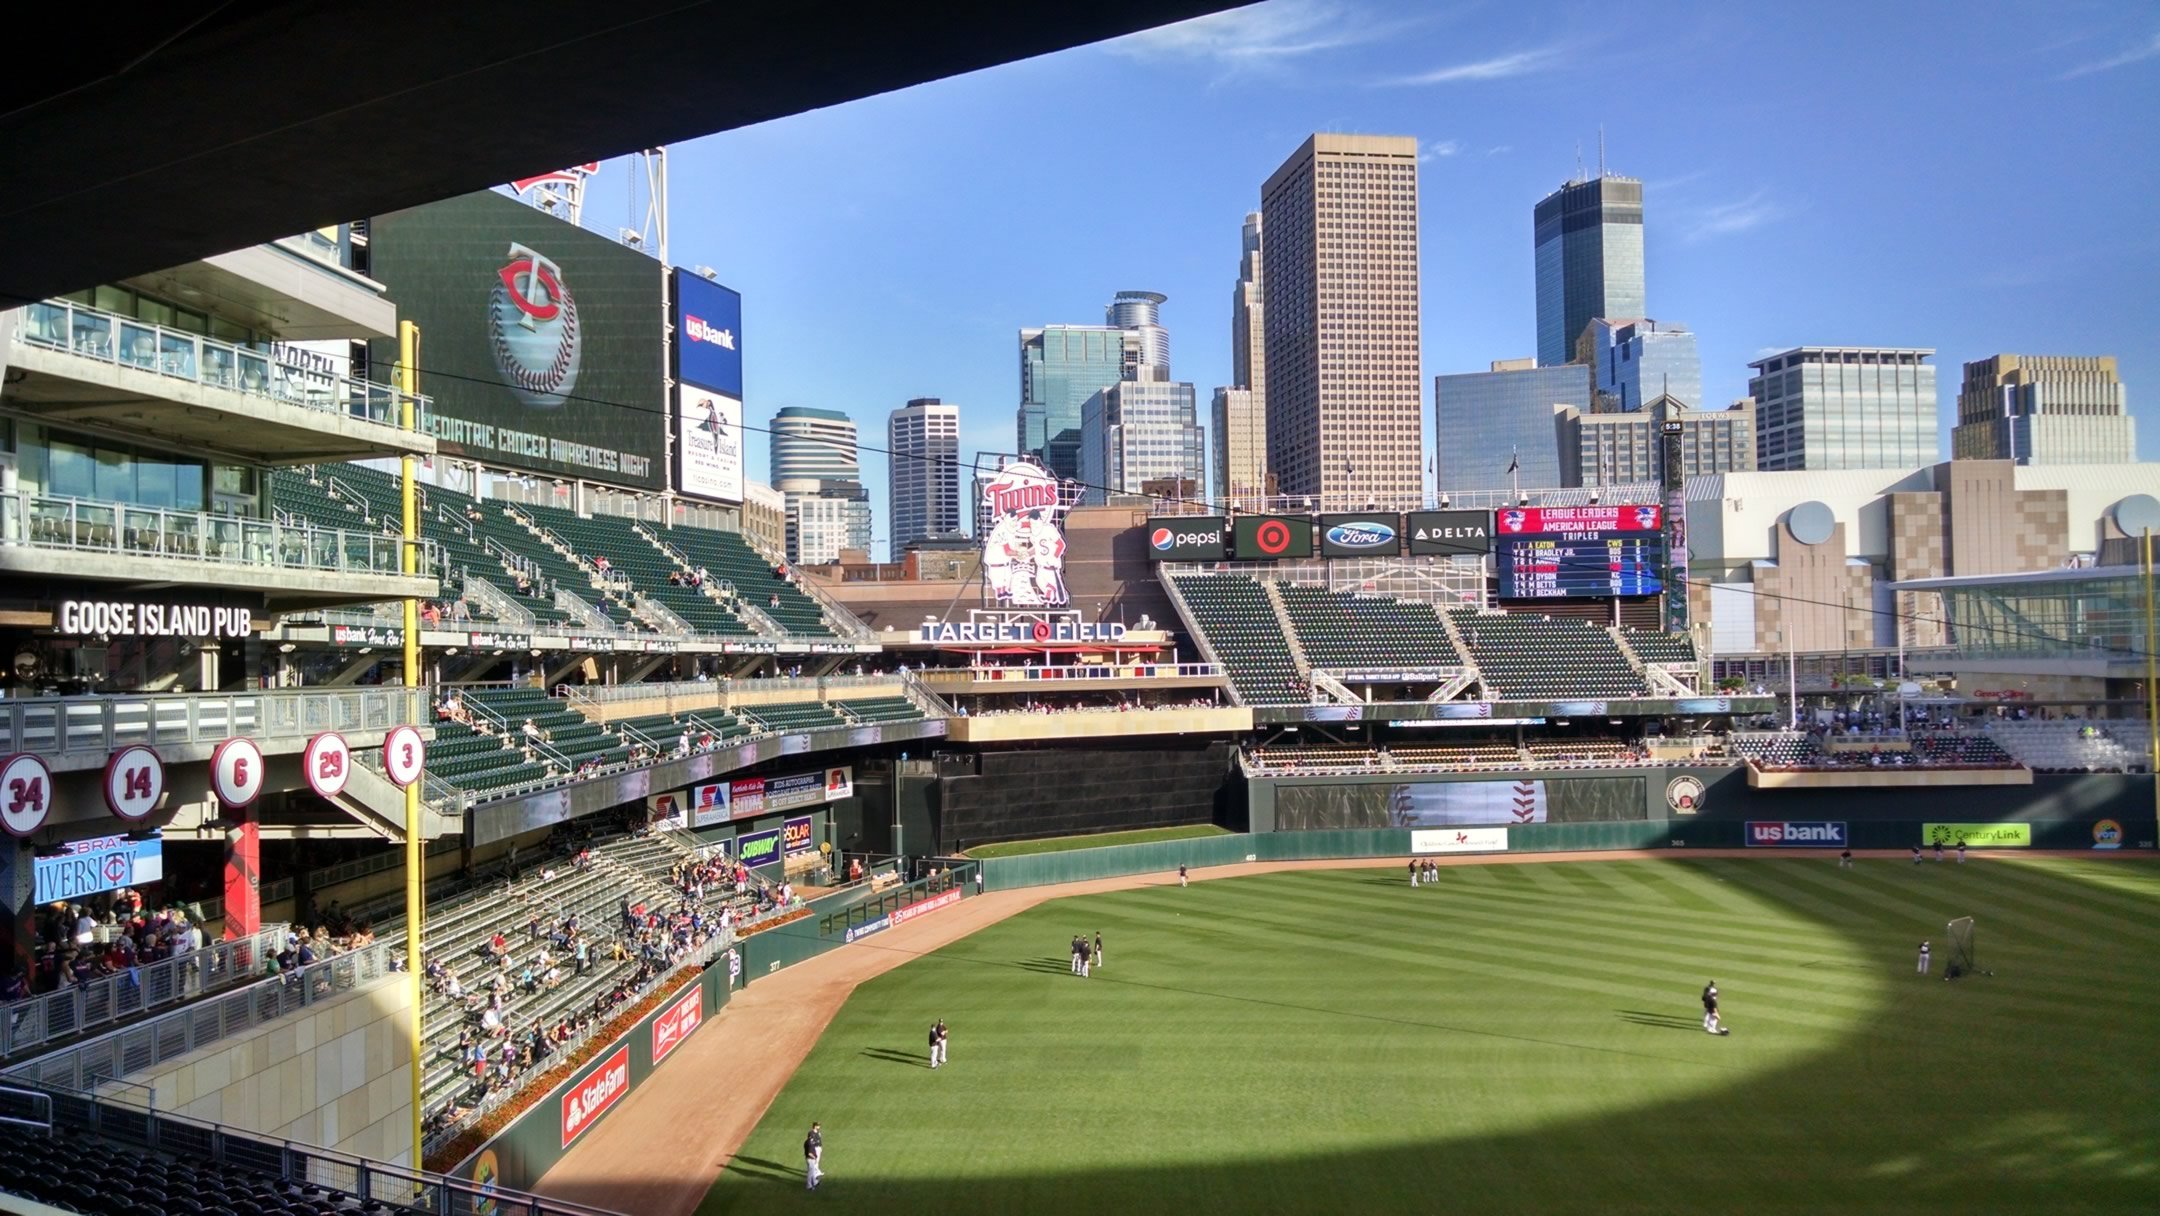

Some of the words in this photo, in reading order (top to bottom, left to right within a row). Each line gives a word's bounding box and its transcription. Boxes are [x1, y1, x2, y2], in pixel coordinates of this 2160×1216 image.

[424, 414, 494, 449] PEDIATRIC
[498, 428, 547, 459] CANCER
[551, 438, 617, 472] AWARENESS
[620, 454, 650, 478] NIGHT
[719, 438, 736, 457] Island
[986, 480, 1057, 518] Twins
[1541, 508, 1575, 519] LEAGUE
[1577, 507, 1619, 519] LEADERS
[1432, 527, 1485, 539] DELTA
[1543, 521, 1585, 532] AMERICAN
[1587, 520, 1617, 530] LEAGUE
[1176, 530, 1220, 547] pepsi
[1340, 528, 1381, 543] Ford
[1563, 532, 1599, 540] TRIPLES
[1536, 549, 1564, 557] BRADLEY
[1536, 581, 1556, 589] BETTS
[1537, 588, 1567, 597] BECKHAM
[64, 600, 135, 635] GOOSE
[138, 604, 210, 637] ISLAND
[214, 607, 251, 638] PUB
[367, 628, 385, 645] Home
[922, 622, 1030, 641] TARGET
[1056, 622, 1127, 641] FIELD
[402, 743, 413, 768] 3
[233, 758, 248, 788] 6
[320, 751, 342, 778] 29
[125, 767, 152, 800] 14
[9, 777, 43, 813] 34
[1955, 830, 2020, 841] CenturyLink
[740, 835, 779, 860] SUBWAY
[769, 960, 780, 972] 377
